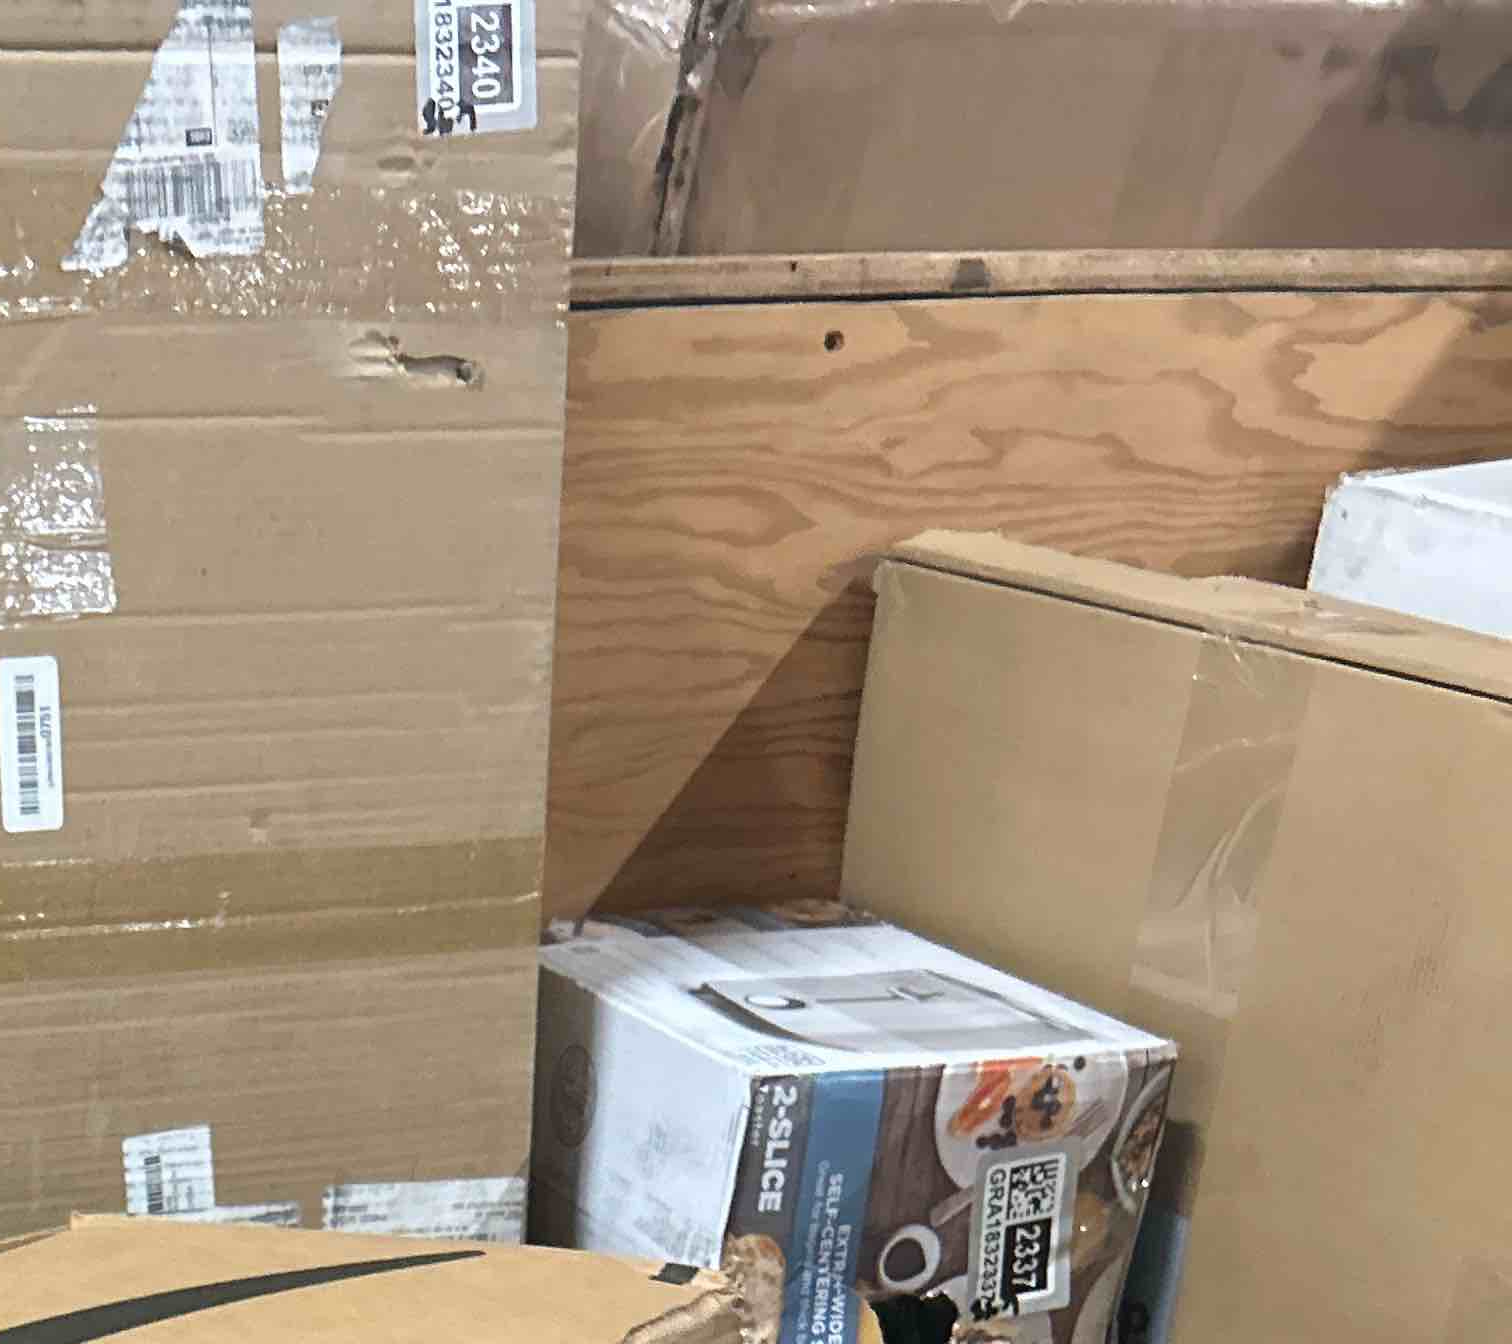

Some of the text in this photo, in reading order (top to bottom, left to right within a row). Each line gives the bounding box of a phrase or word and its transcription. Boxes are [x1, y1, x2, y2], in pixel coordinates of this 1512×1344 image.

[471, 10, 501, 99] 2340
[757, 1085, 798, 1213] 2-SLICE
[980, 1168, 1007, 1302] GRA1832337
[1011, 1223, 1042, 1288] 2337
